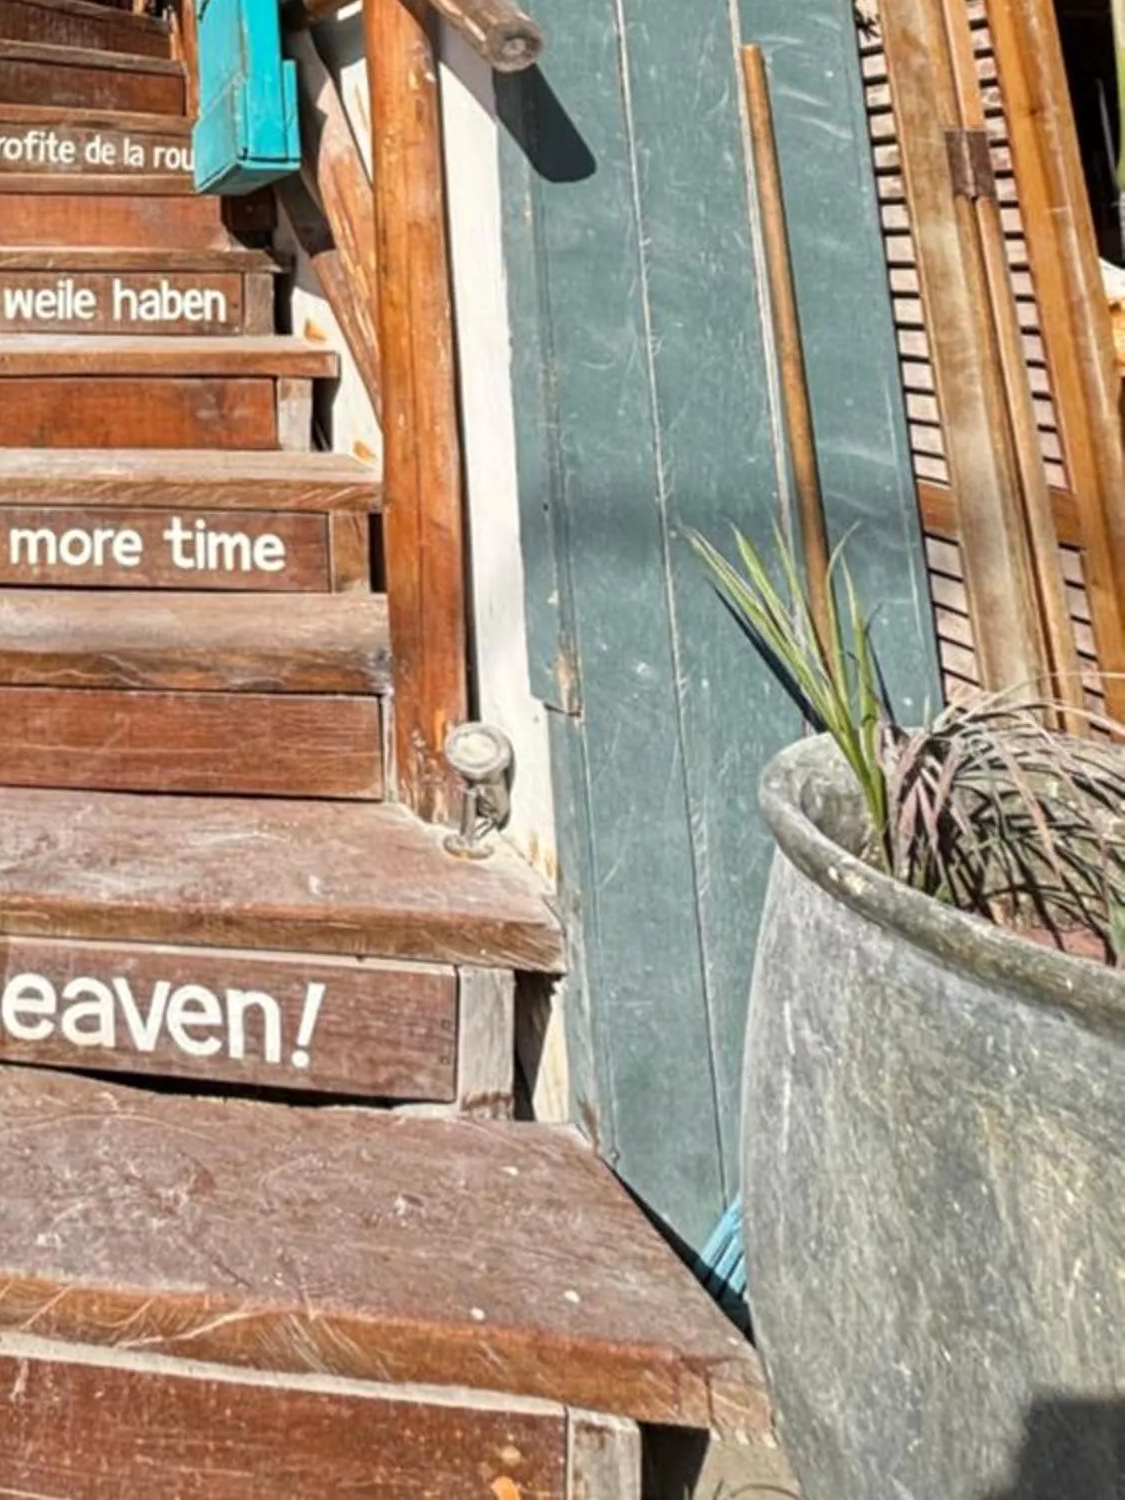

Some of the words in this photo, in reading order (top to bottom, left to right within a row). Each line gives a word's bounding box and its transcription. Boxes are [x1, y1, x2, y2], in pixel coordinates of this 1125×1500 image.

[85, 135, 116, 165] de
[124, 138, 145, 167] la
[3, 278, 96, 321] weile
[113, 279, 228, 323] haben
[9, 526, 145, 567] more
[164, 515, 287, 572] time
